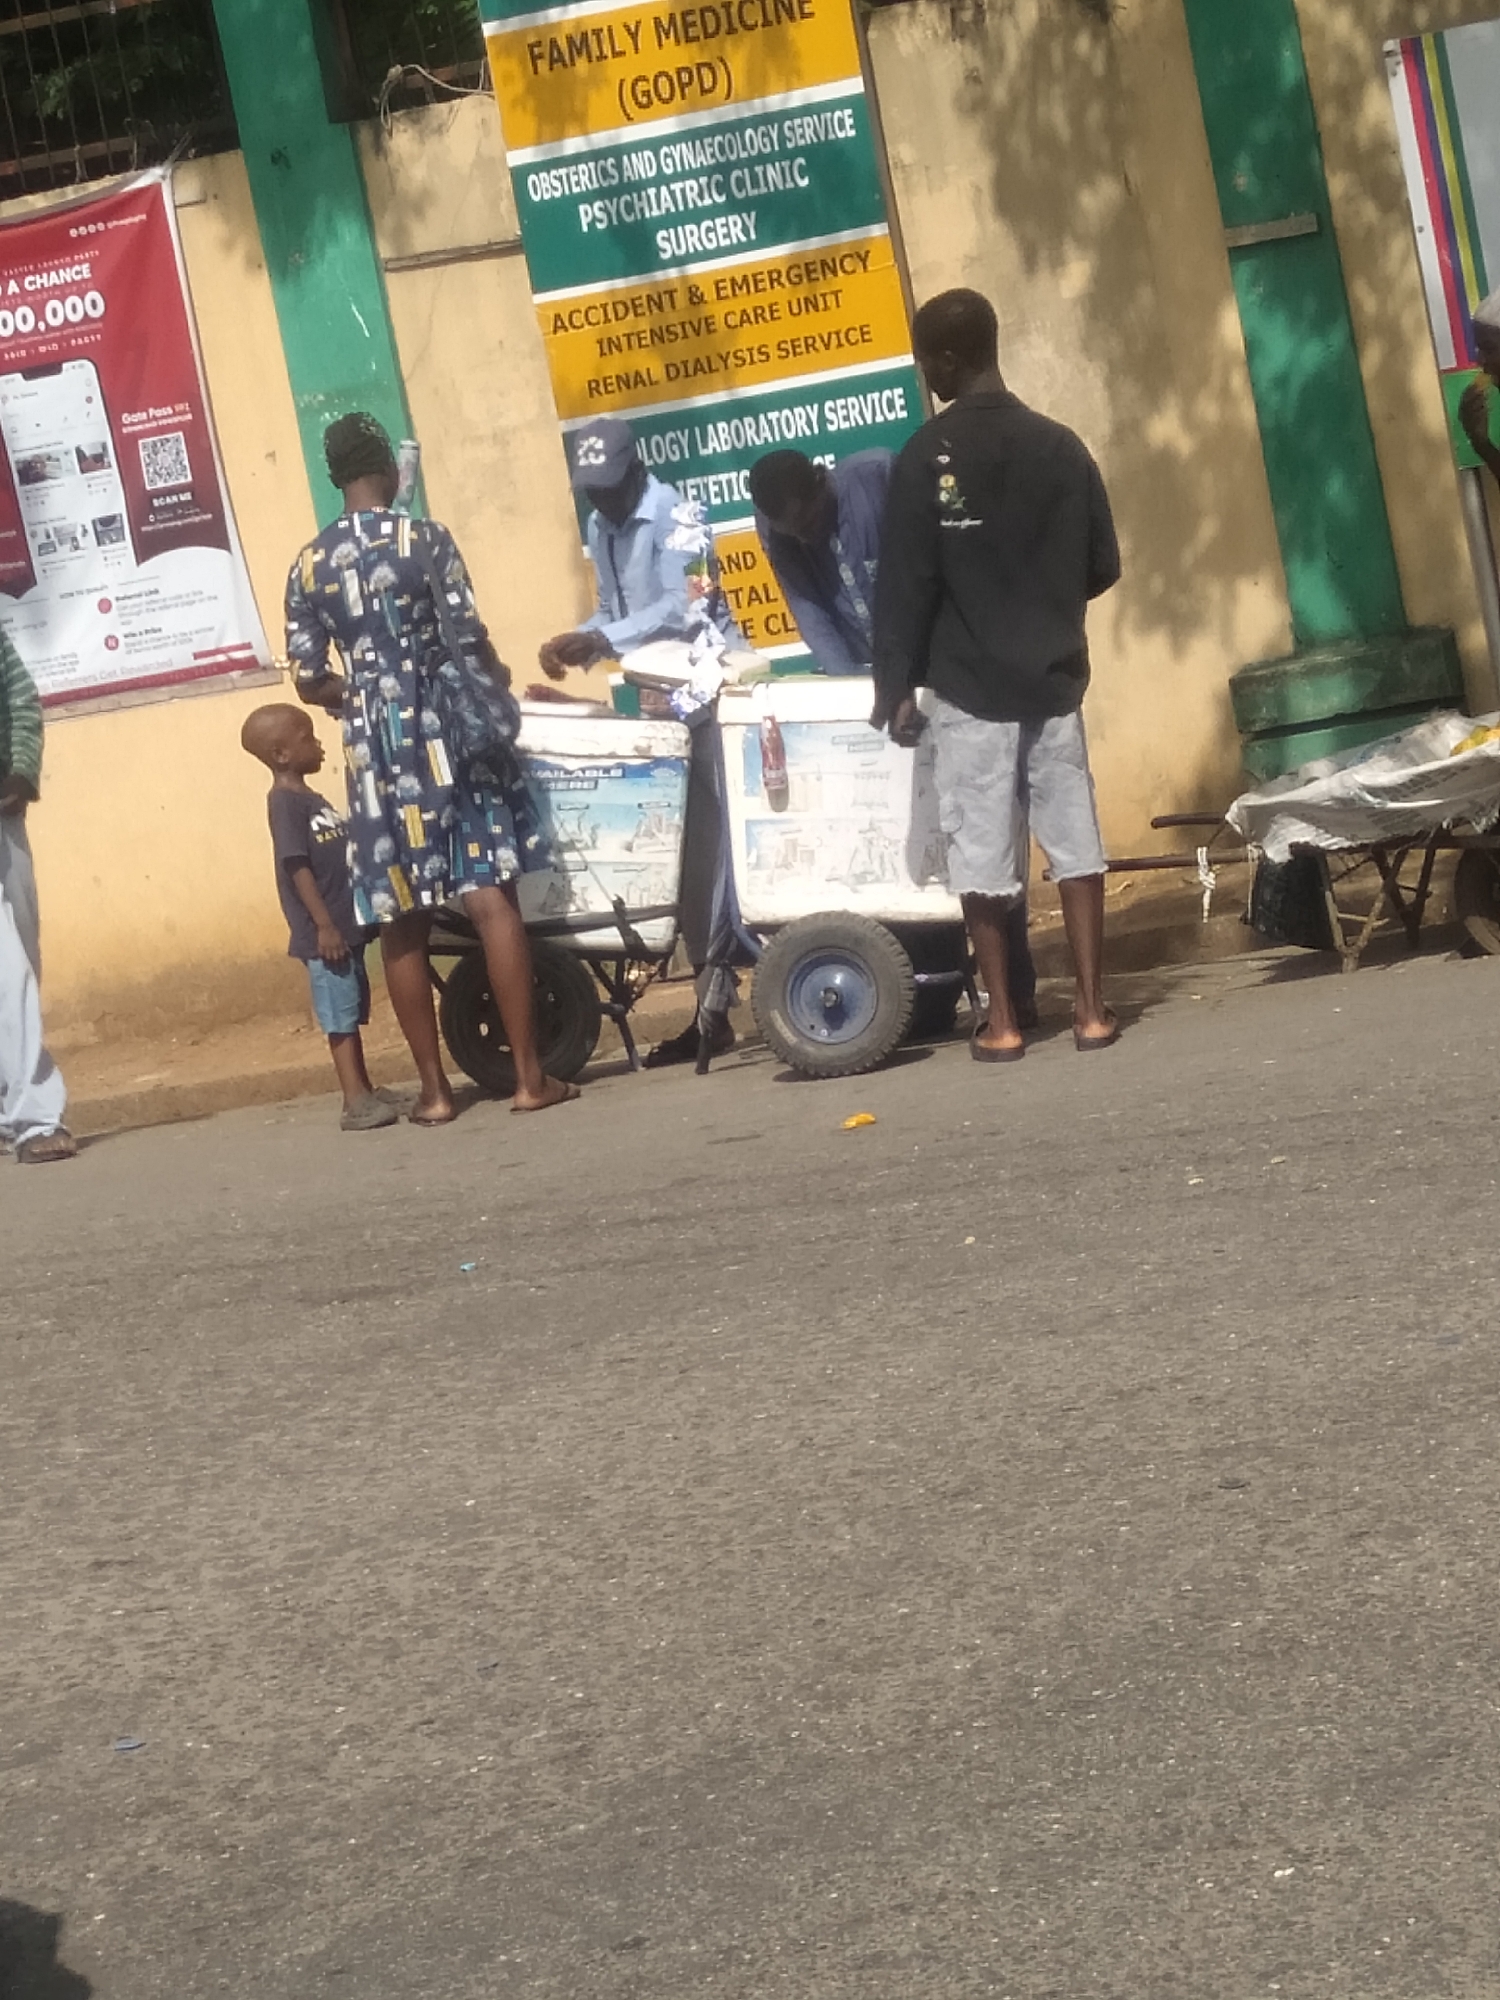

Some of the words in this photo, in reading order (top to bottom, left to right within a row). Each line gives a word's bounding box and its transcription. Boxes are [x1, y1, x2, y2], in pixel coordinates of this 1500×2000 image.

[527, 20, 645, 76] FAMILY
[653, 0, 815, 50] MEDICINE
[618, 56, 734, 121] (GOPD)
[527, 158, 618, 202] OBSTERICS
[623, 150, 657, 183] AND
[659, 122, 780, 174] GYNAECOLOGY
[783, 108, 856, 149] SERVICE
[578, 174, 726, 232] PSYCHIATRIC
[730, 158, 809, 199] CLINIC
[656, 211, 758, 259] SURGERY
[7, 279, 20, 296] A
[24, 262, 92, 291] CHANCE
[552, 285, 678, 335] ACCIDENT
[688, 283, 707, 305] &
[715, 250, 871, 302] EMERGENCY
[597, 319, 716, 357] INTENSIVE
[724, 301, 781, 330] CARE
[787, 289, 843, 317] UNIT
[587, 371, 658, 399] RENAL
[665, 345, 770, 383] DIALYSIS
[777, 324, 873, 360] SERVICE
[636, 428, 690, 467] LOGY
[695, 402, 819, 456] LABORATORY
[824, 387, 908, 428] SERVICE
[676, 470, 750, 506] IETETIC
[723, 583, 778, 609] TAL
[764, 611, 797, 637] CL
